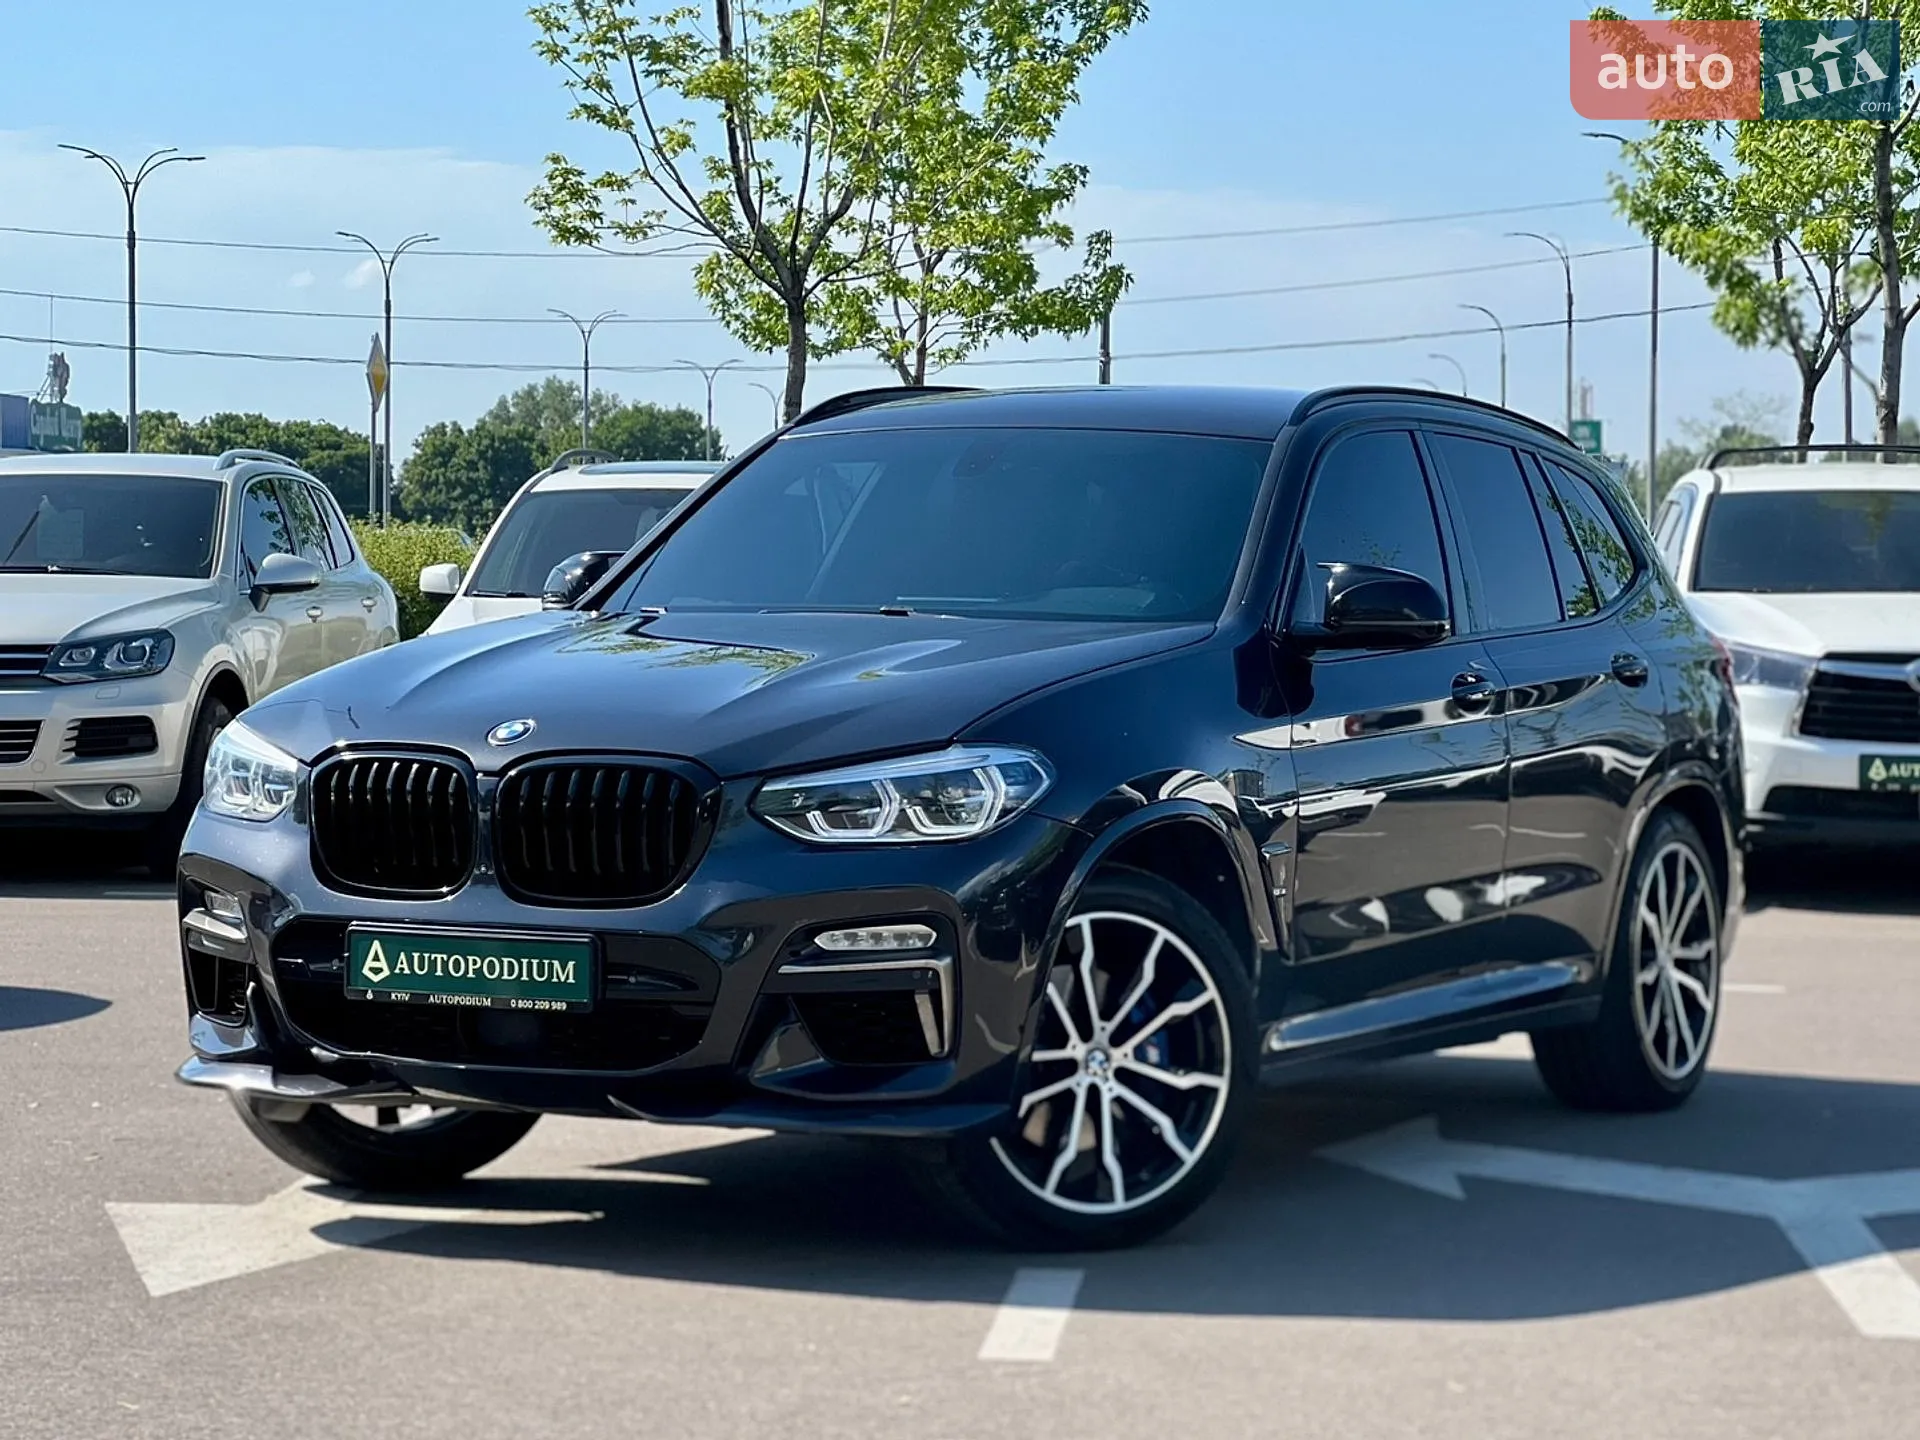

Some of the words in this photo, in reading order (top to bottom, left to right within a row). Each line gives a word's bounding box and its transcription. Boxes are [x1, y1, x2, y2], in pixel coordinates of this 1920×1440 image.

[394, 951, 576, 983] AUTOPODIUM
[390, 991, 410, 1001] KYIV
[428, 994, 491, 1007] AUTOPODIUM
